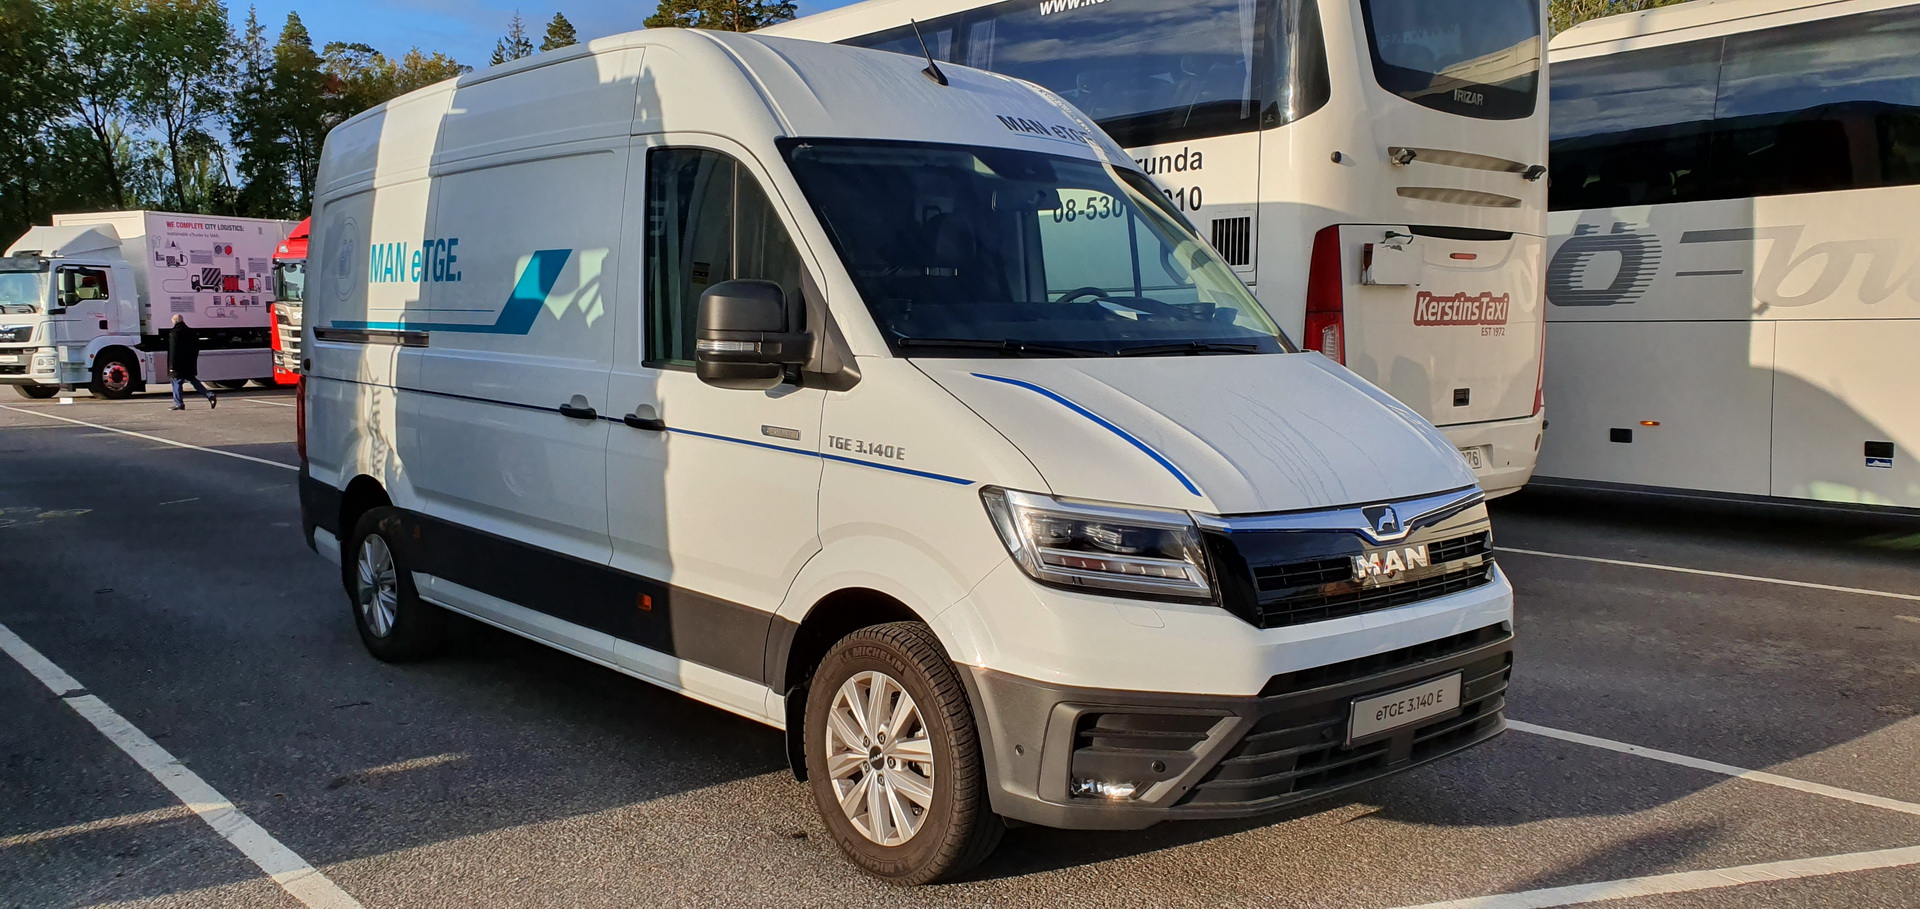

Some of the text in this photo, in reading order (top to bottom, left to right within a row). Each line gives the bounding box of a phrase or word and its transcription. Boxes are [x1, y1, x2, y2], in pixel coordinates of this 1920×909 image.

[1453, 88, 1484, 106] IRIZAR
[996, 114, 1052, 136] MAN
[176, 222, 204, 230] COMPLETE
[369, 238, 462, 283] MAN eTGE.
[1481, 327, 1505, 336] EST 1972
[828, 435, 905, 460] TGE 3.140 E
[1355, 545, 1428, 579] MAN
[852, 646, 906, 672] MICHELIN
[1376, 689, 1444, 721] eTGE 3.140 E
